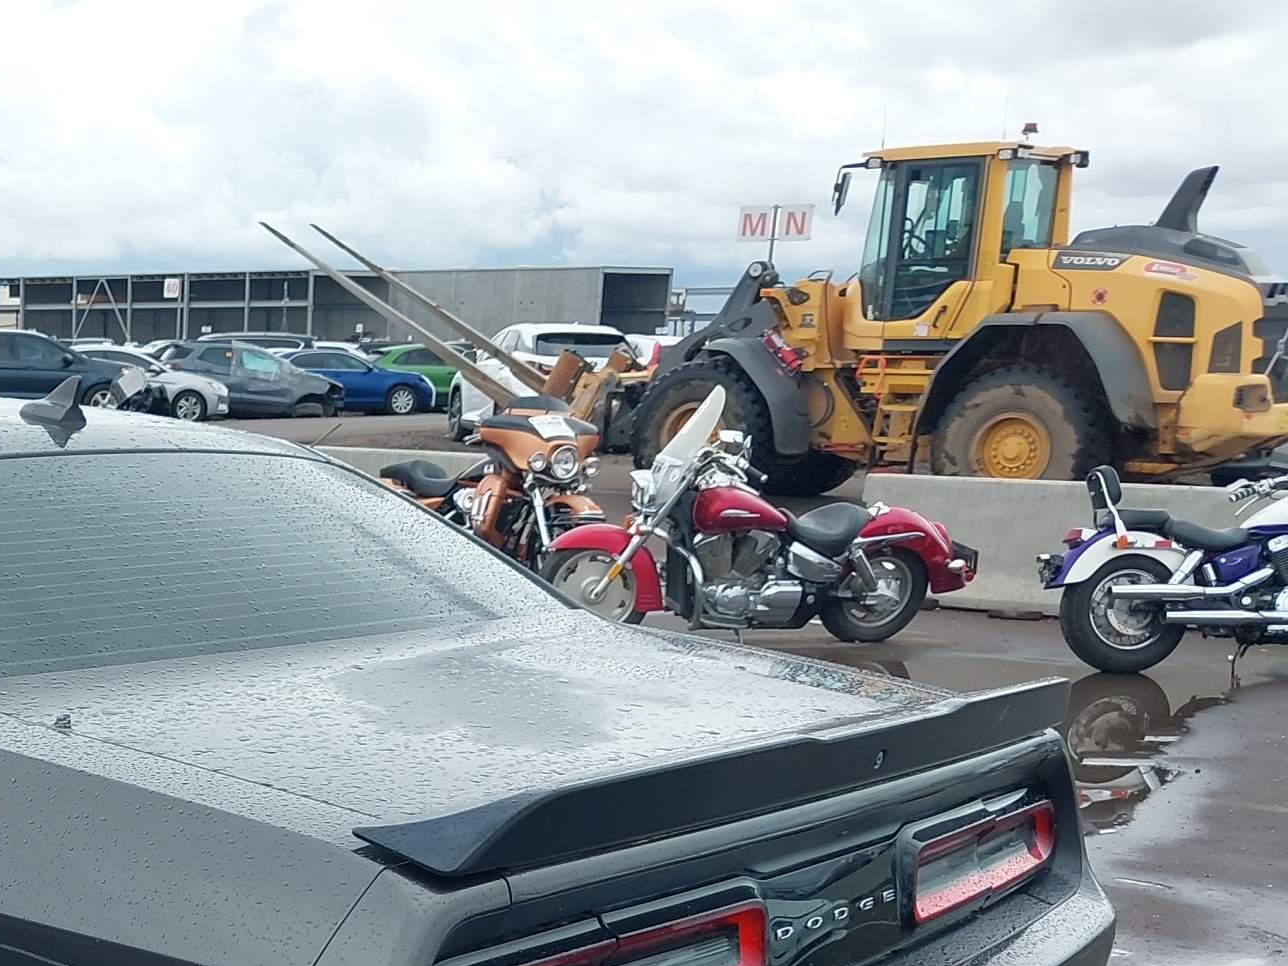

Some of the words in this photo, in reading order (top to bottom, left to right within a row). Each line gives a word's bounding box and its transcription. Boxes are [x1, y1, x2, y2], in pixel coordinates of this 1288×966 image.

[742, 212, 767, 236] M
[785, 211, 807, 236] N
[1062, 256, 1120, 266] VOLVO
[775, 889, 896, 940] DODGE
